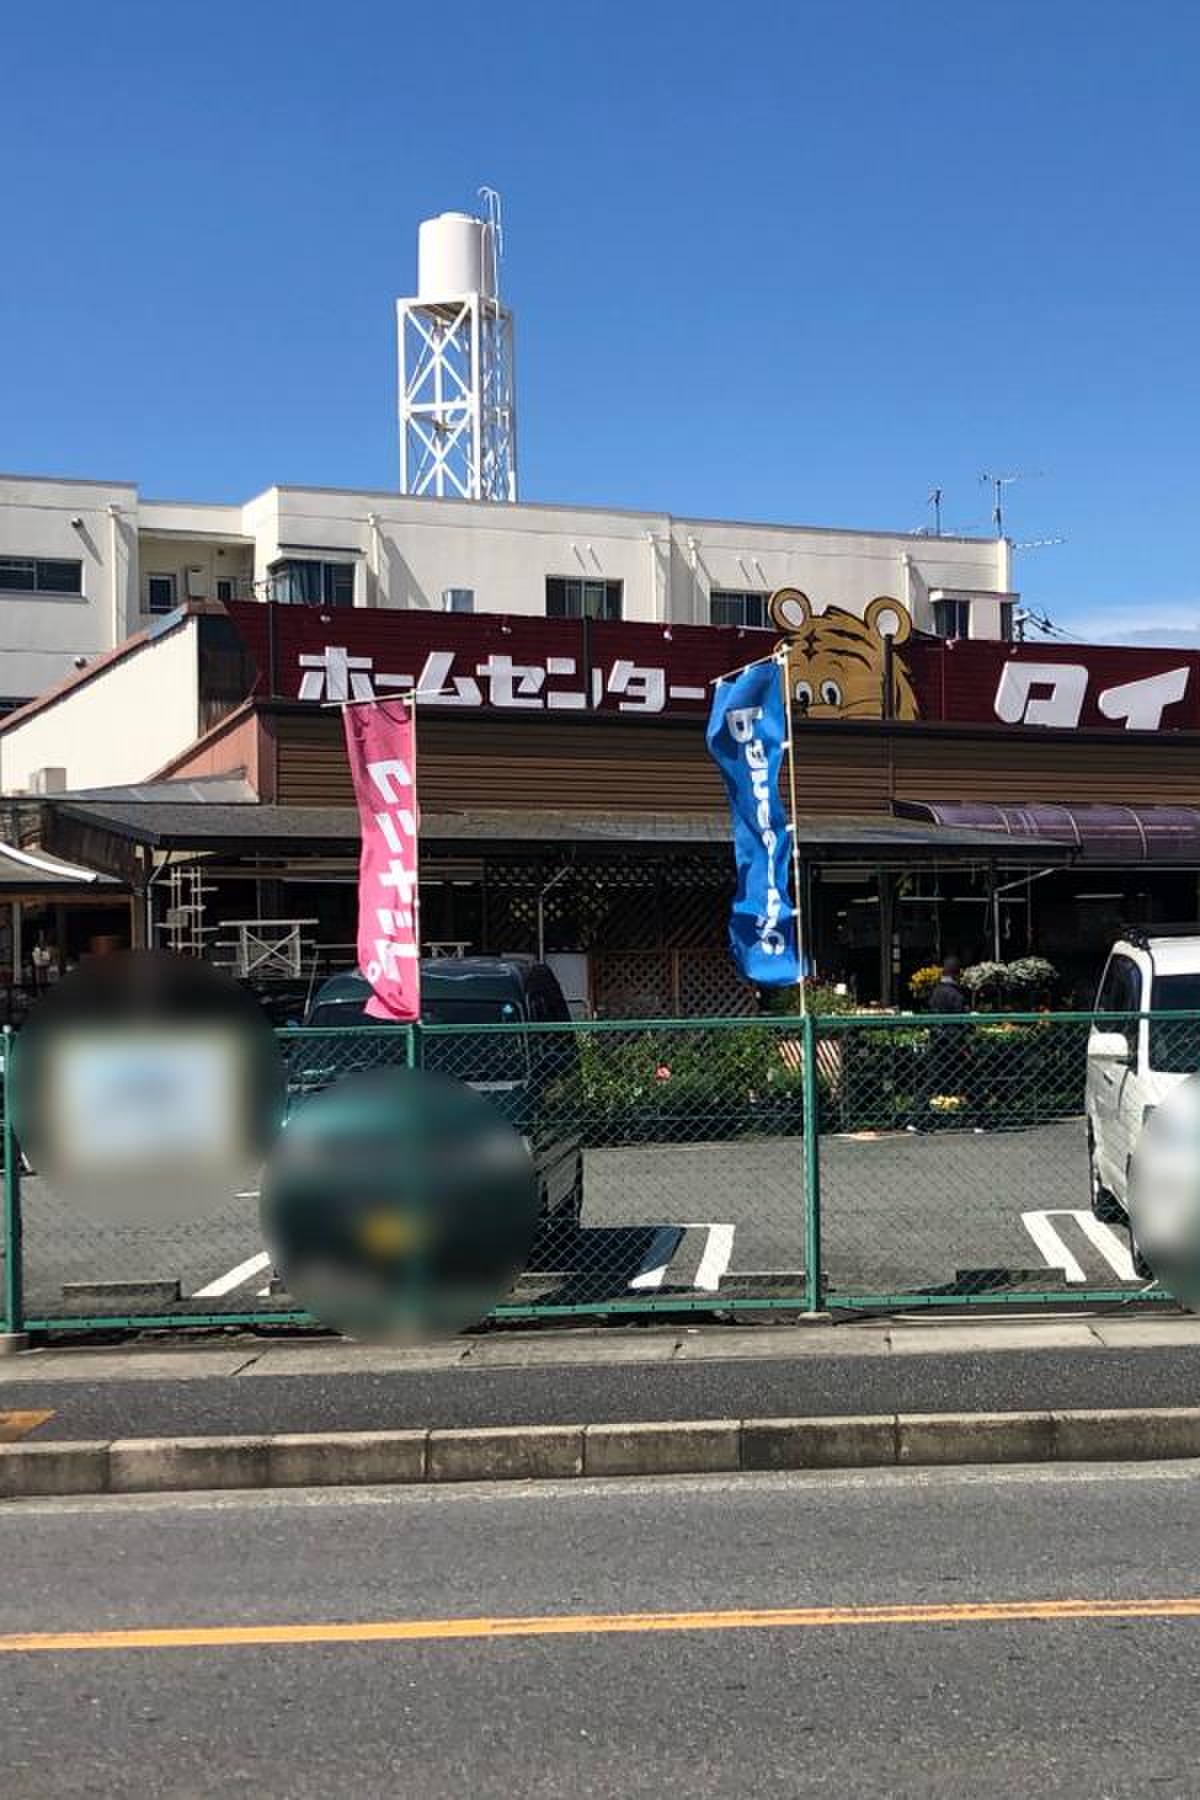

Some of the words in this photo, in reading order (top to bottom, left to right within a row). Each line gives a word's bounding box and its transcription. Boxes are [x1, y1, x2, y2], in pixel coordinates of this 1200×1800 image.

[298, 646, 706, 713] ホームセンター
